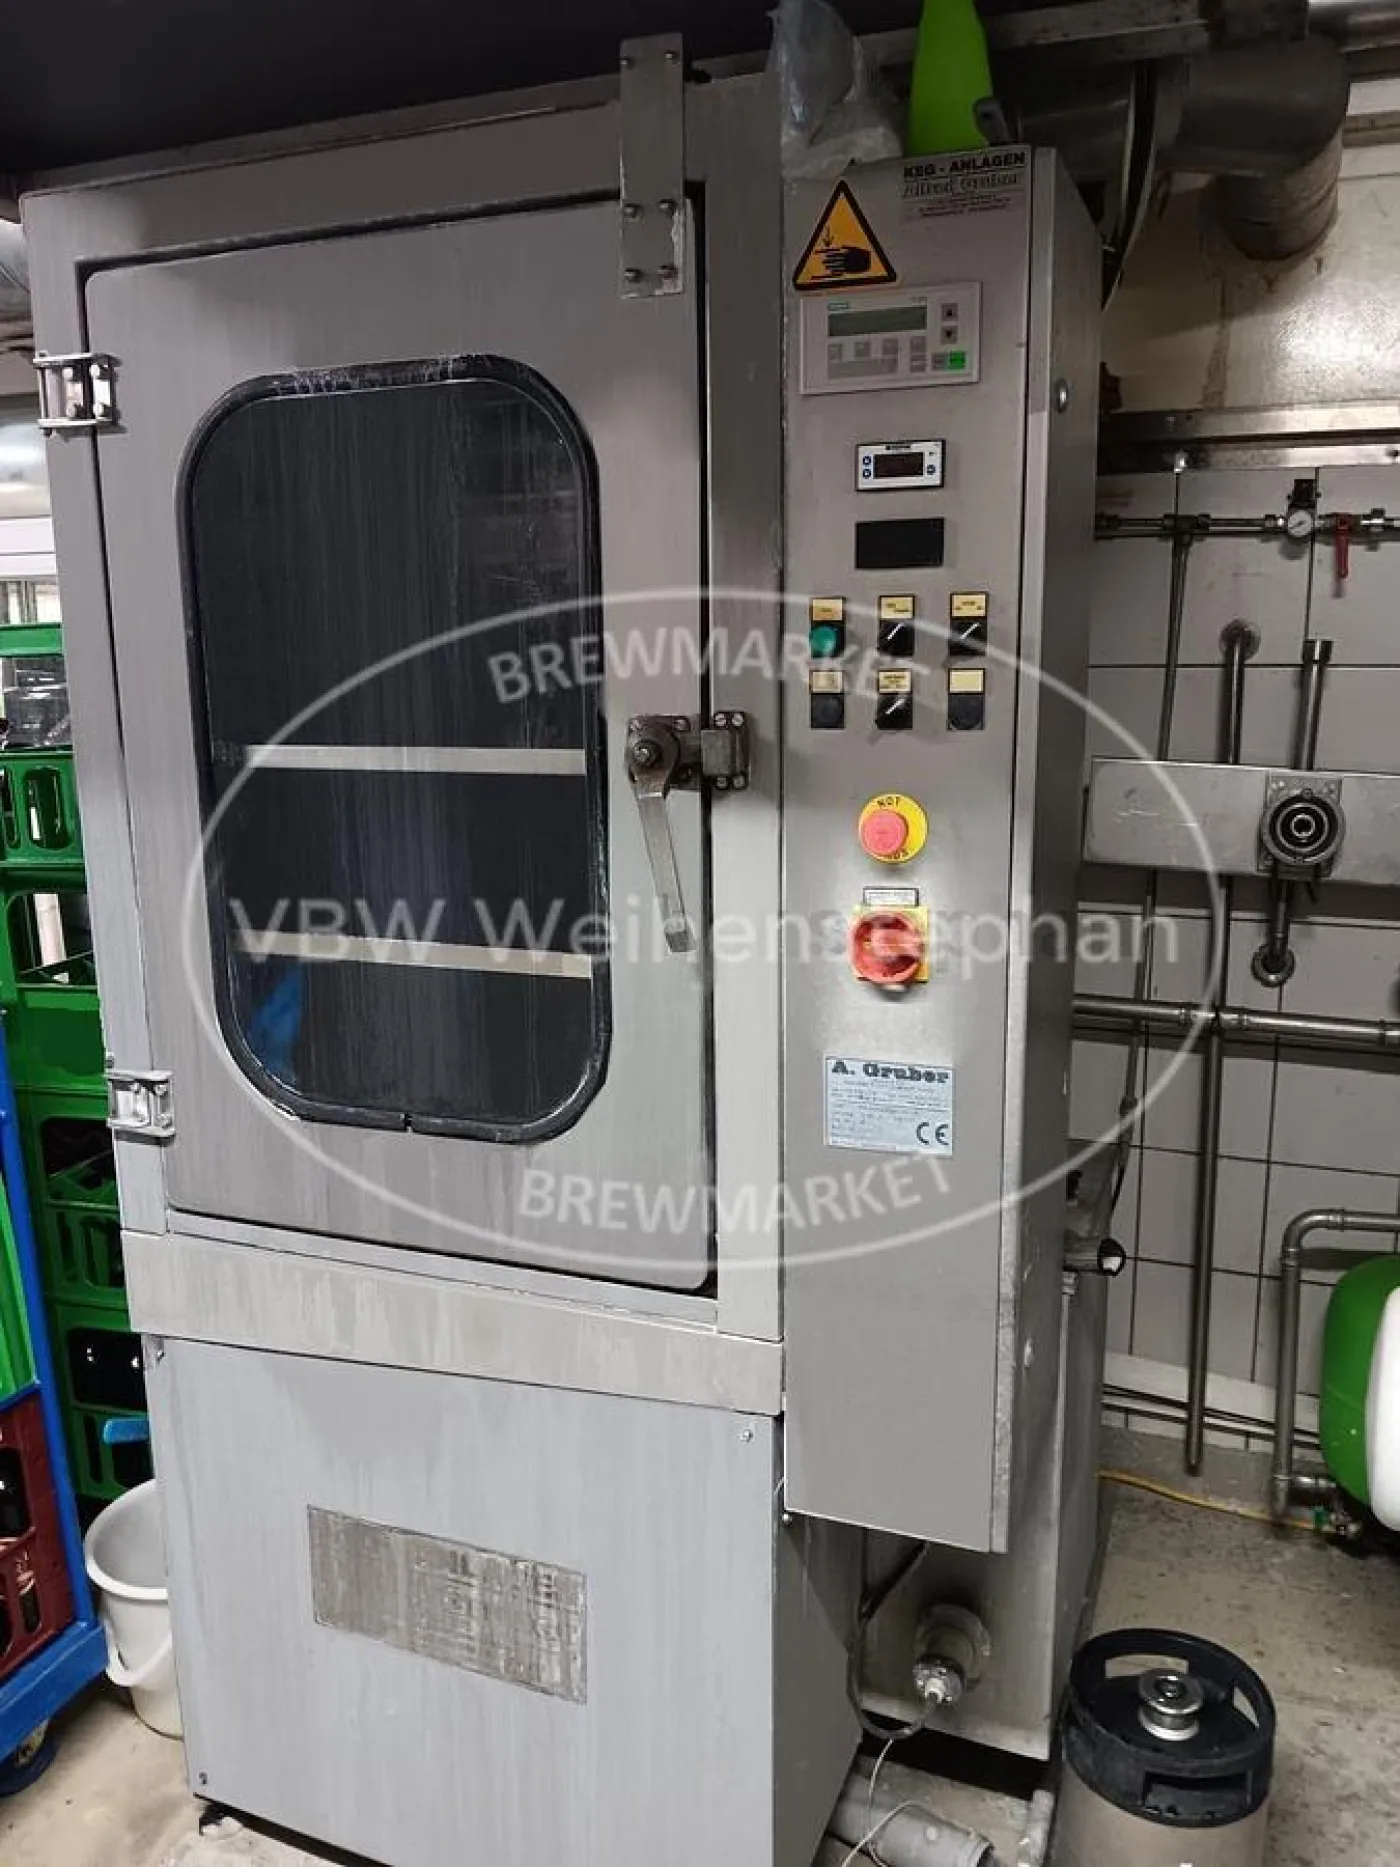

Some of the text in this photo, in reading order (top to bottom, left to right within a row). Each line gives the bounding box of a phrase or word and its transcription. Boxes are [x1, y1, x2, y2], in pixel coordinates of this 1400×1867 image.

[903, 163, 936, 179] KEG
[949, 151, 1026, 173] ANLAGEN
[876, 797, 901, 809] NOT
[831, 1059, 950, 1084] A. Gruber
[915, 1121, 950, 1146] CE
